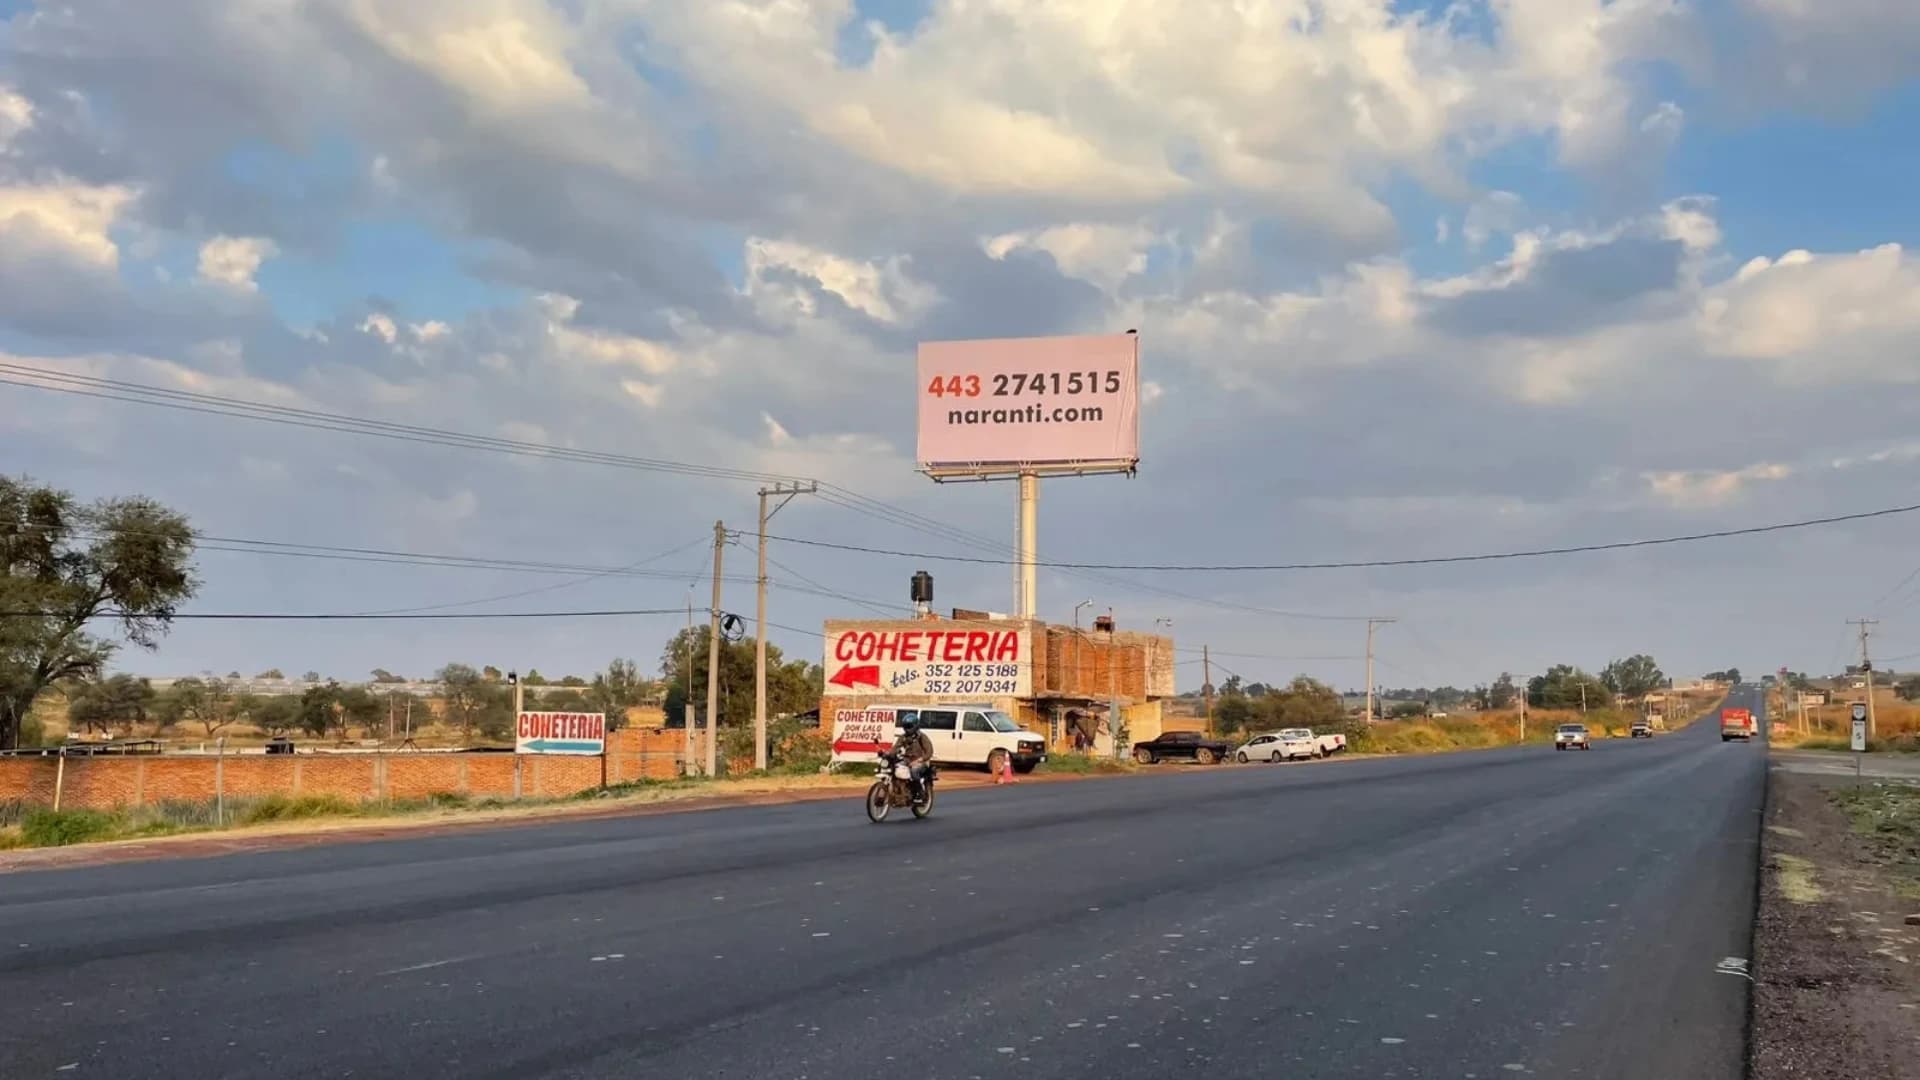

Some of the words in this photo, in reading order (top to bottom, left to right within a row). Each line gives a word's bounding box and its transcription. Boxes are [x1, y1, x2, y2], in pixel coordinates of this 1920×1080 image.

[928, 375, 981, 397] 443
[992, 371, 1120, 396] 2741515
[948, 403, 1102, 424] naranti.com
[835, 631, 1018, 662] COHETERIA
[890, 669, 920, 688] tels.
[925, 665, 953, 677] 352
[958, 665, 982, 677] 125
[985, 664, 1018, 677] 5188
[924, 680, 951, 693] 352
[956, 680, 981, 693] 207
[984, 680, 1017, 693] 9341
[518, 713, 603, 739] COHETERIA
[837, 711, 895, 723] COHETERIA
